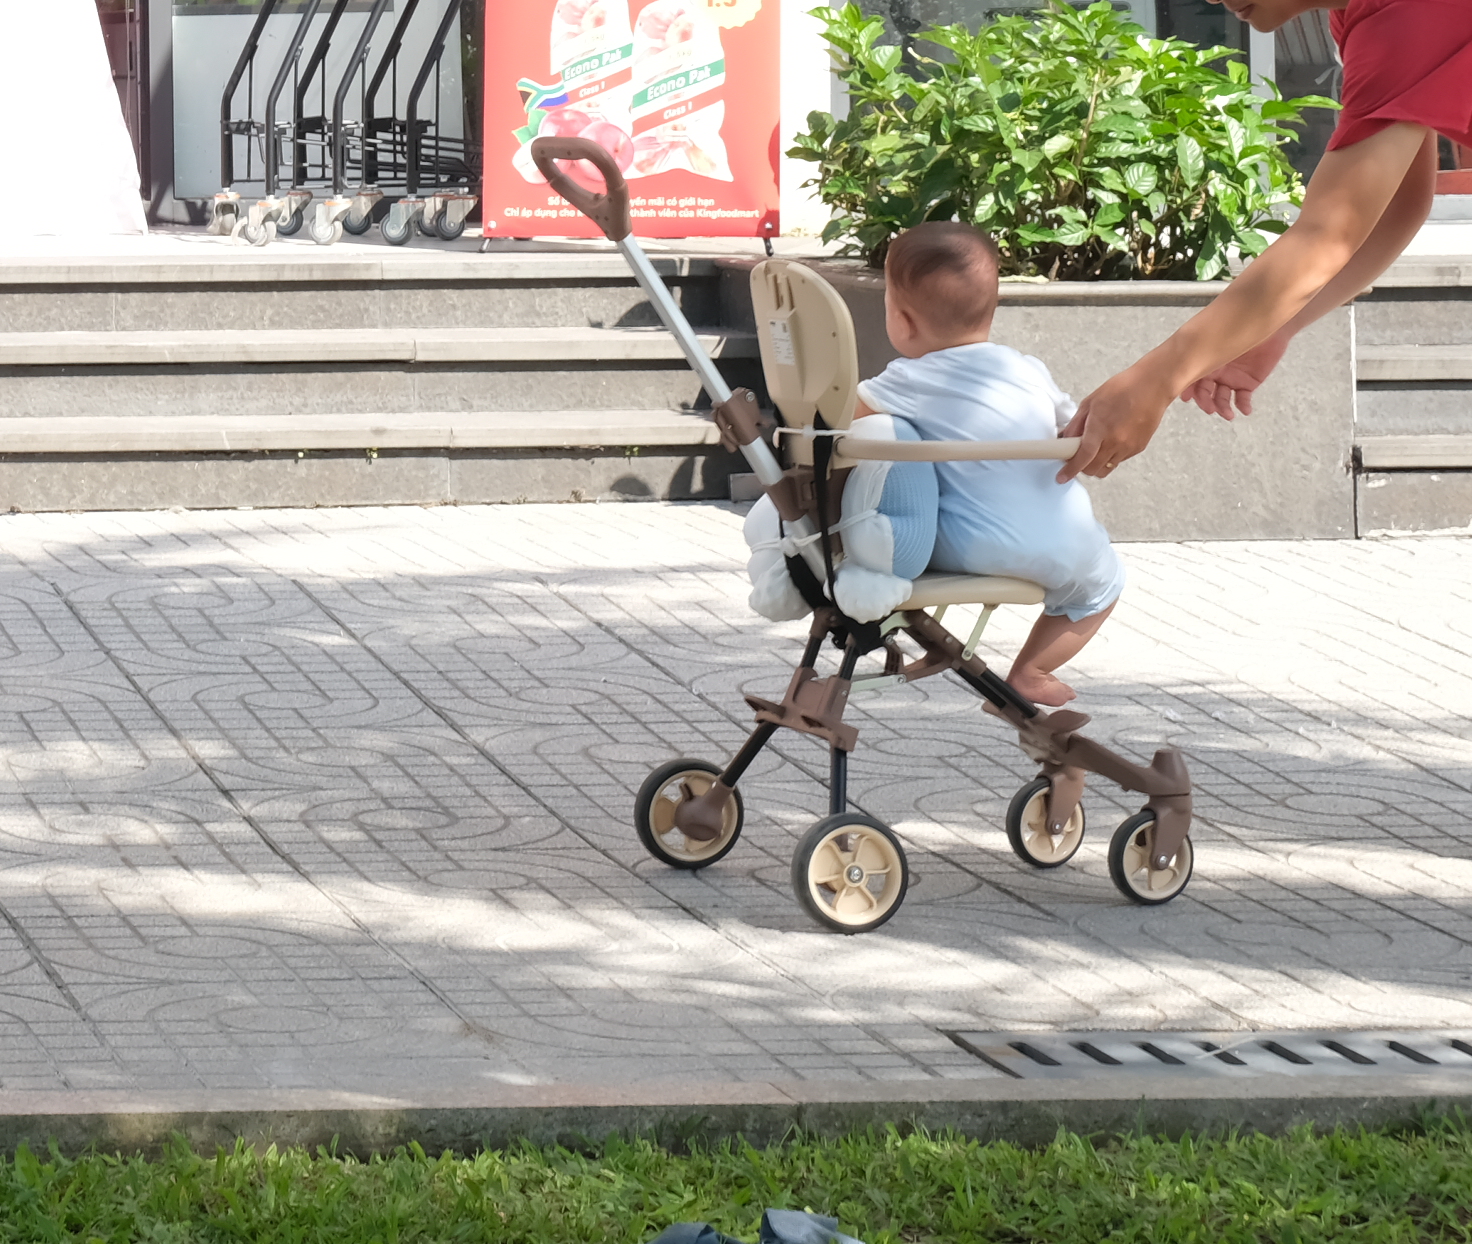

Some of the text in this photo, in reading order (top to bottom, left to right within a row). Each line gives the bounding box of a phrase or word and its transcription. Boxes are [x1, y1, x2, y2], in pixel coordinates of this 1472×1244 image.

[564, 49, 622, 80] Econo Pak
[647, 66, 711, 100] Econo Pak
[666, 197, 677, 206] có
[534, 208, 759, 219] dụng cho Kingfoodmart
